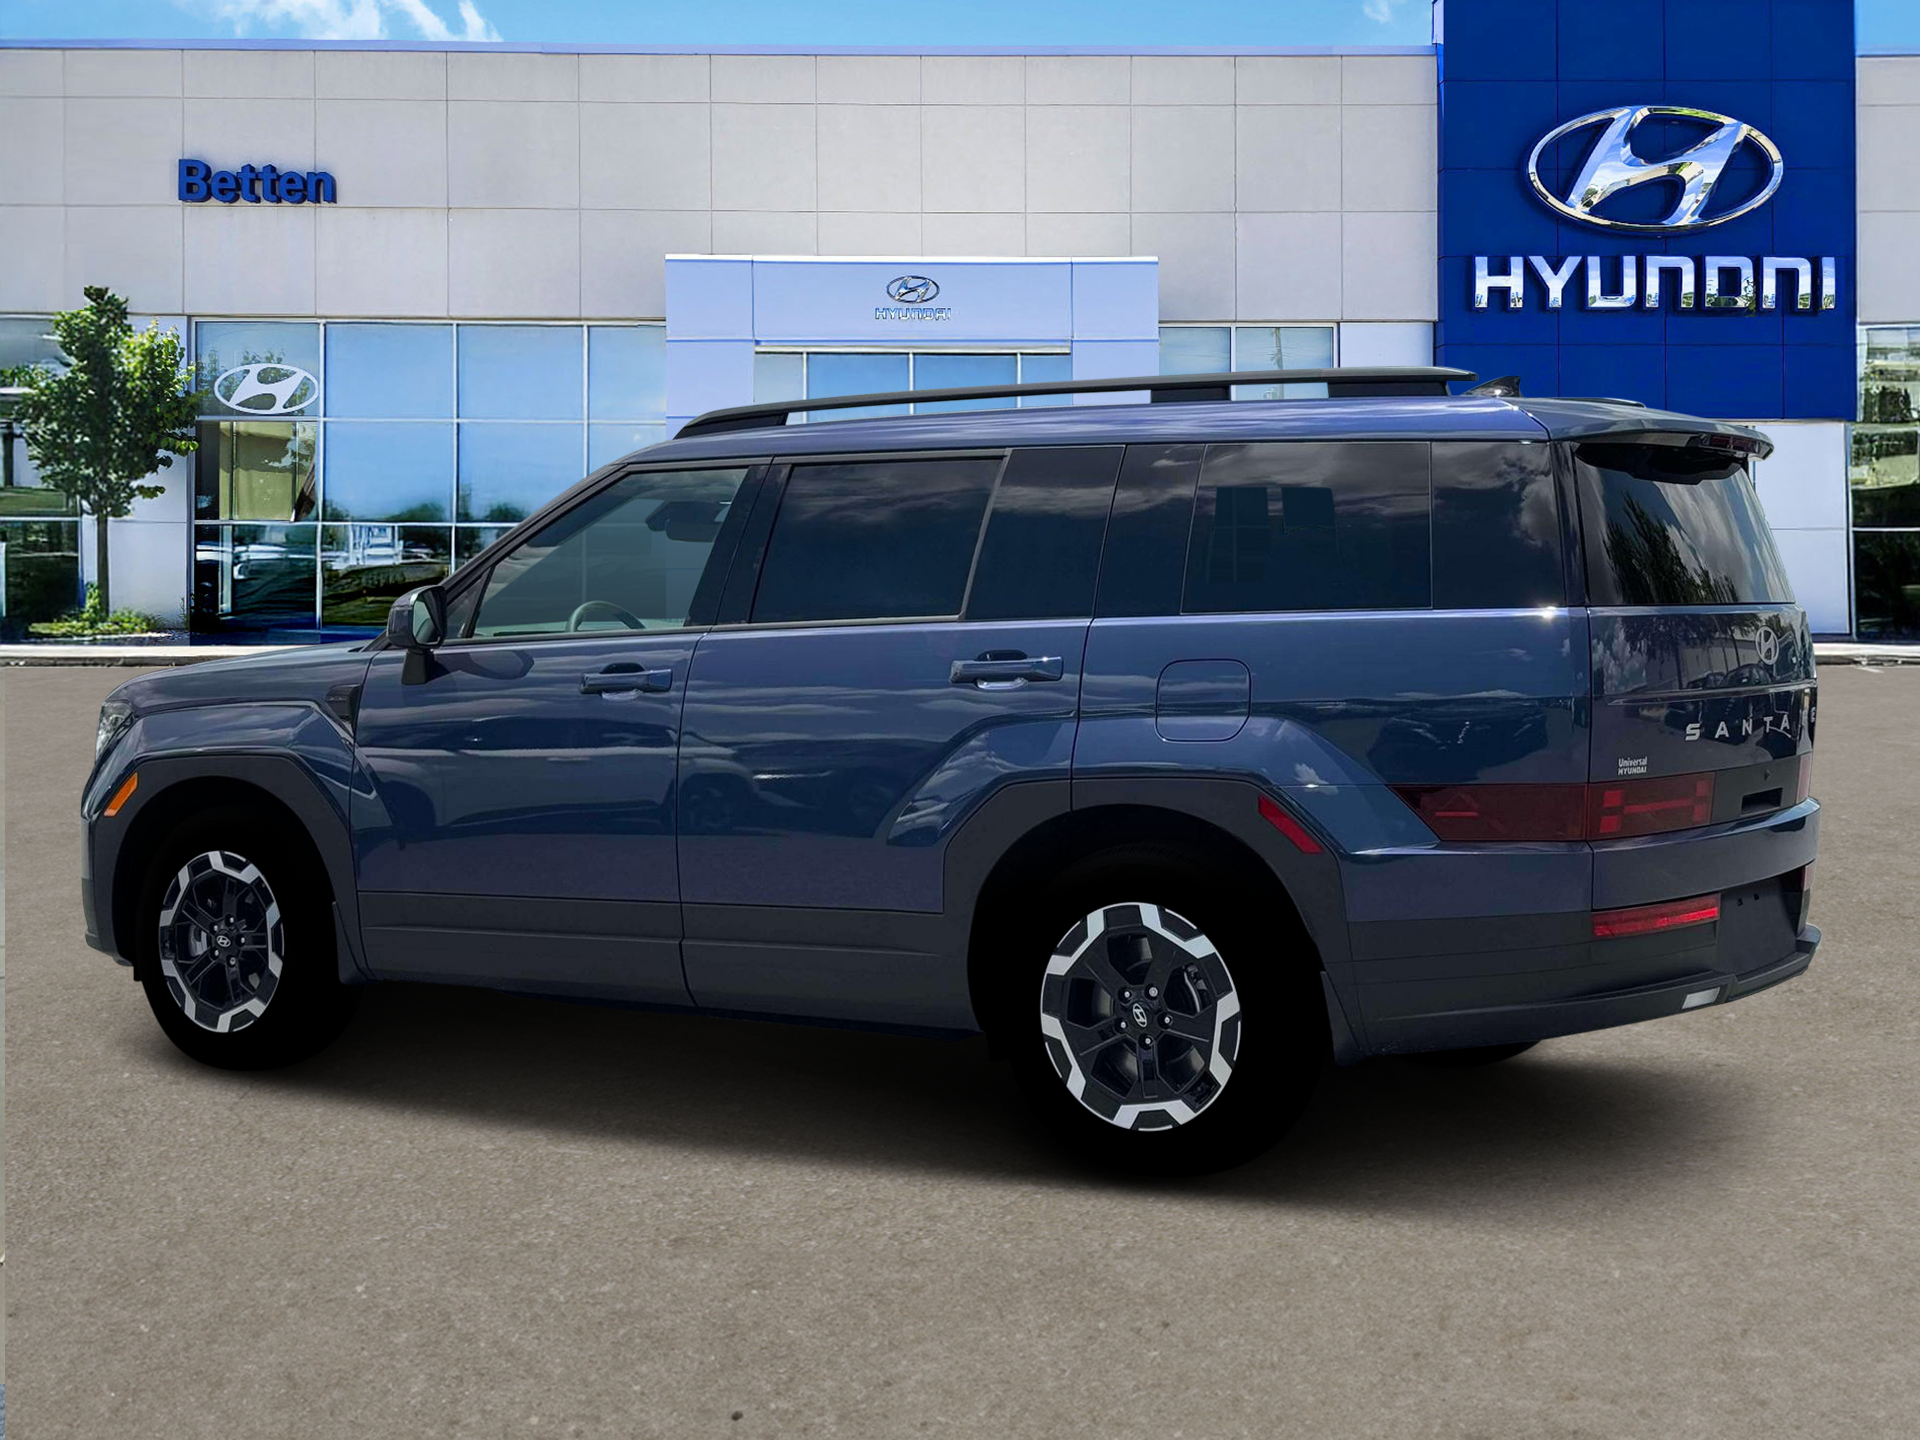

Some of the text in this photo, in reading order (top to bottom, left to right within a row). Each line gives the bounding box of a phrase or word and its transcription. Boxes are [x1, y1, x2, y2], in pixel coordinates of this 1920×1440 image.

[178, 159, 337, 204] Betten
[874, 307, 952, 320] HYUNDAI
[1685, 713, 1790, 742] SANTA
[1618, 756, 1648, 767] Universal
[1617, 766, 1647, 775] HYUNDAI
